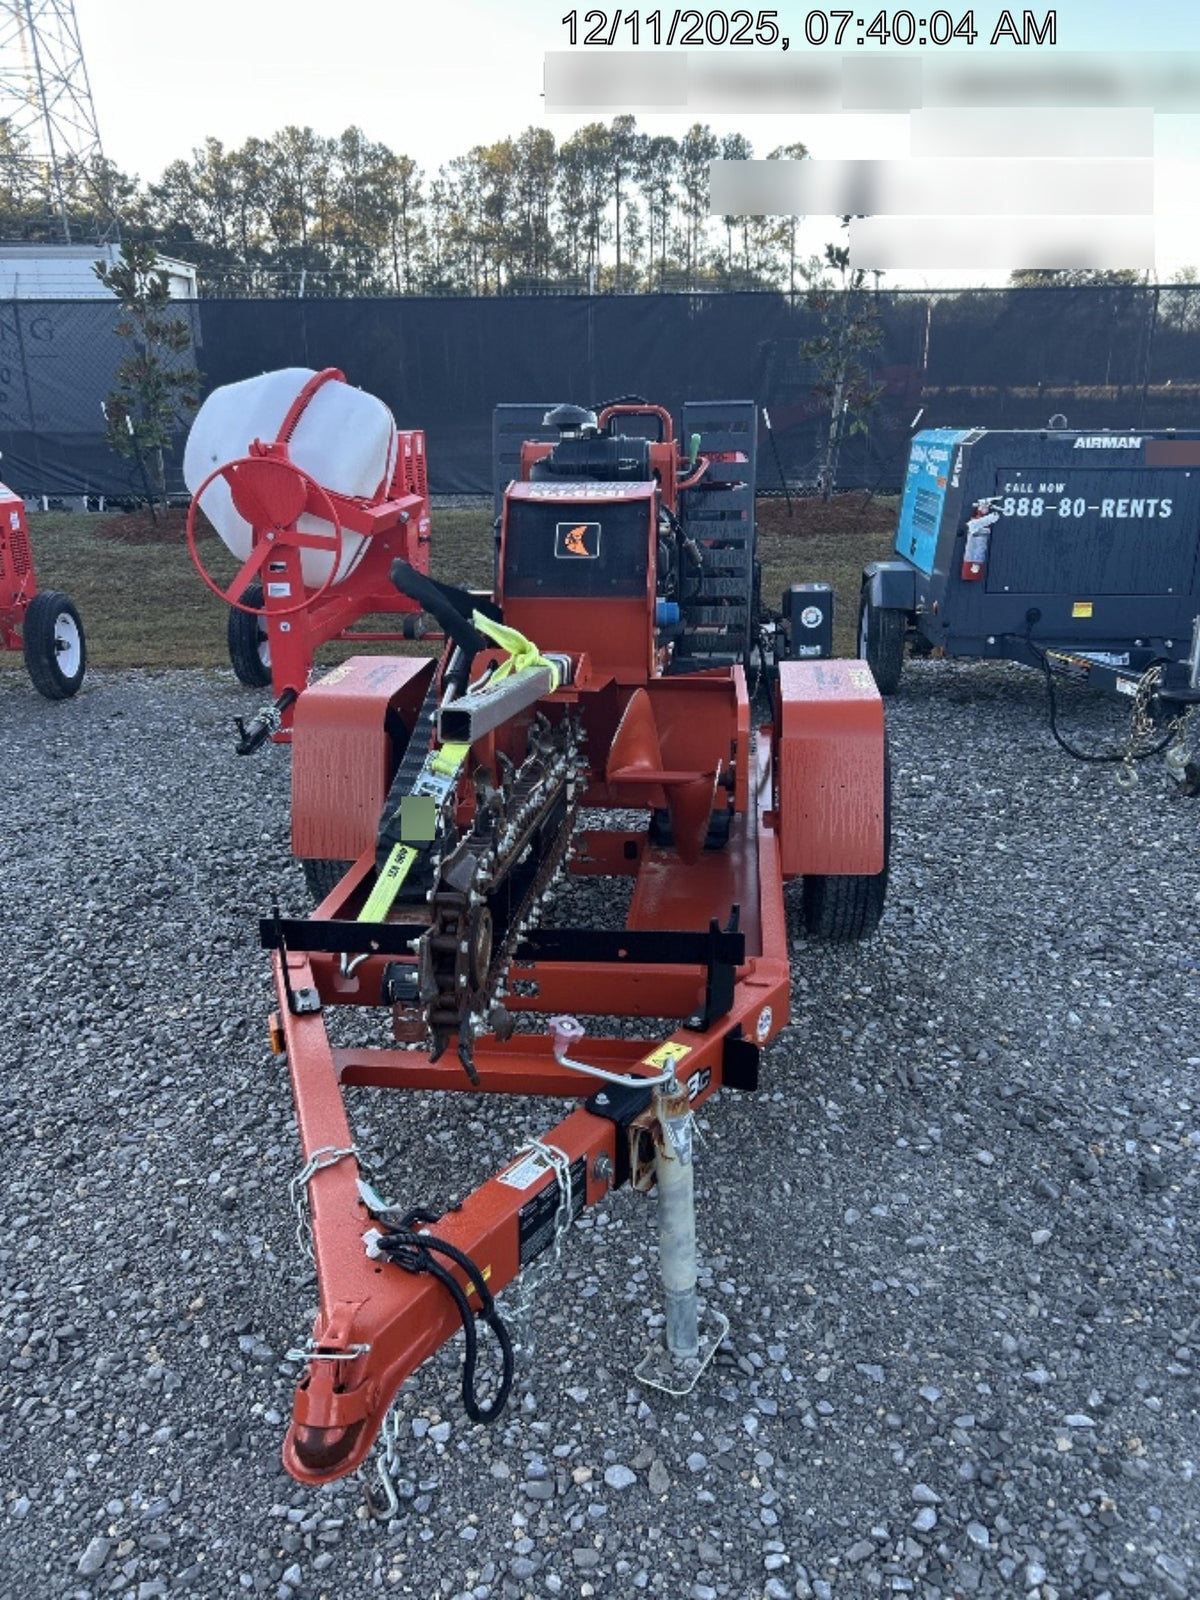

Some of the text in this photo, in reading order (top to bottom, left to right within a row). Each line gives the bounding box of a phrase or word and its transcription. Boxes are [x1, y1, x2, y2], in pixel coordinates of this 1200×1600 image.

[1073, 436, 1143, 449] AIRMAN
[1004, 483, 1066, 493] CALL NOW
[1003, 497, 1173, 518] 888-80-RENTS
